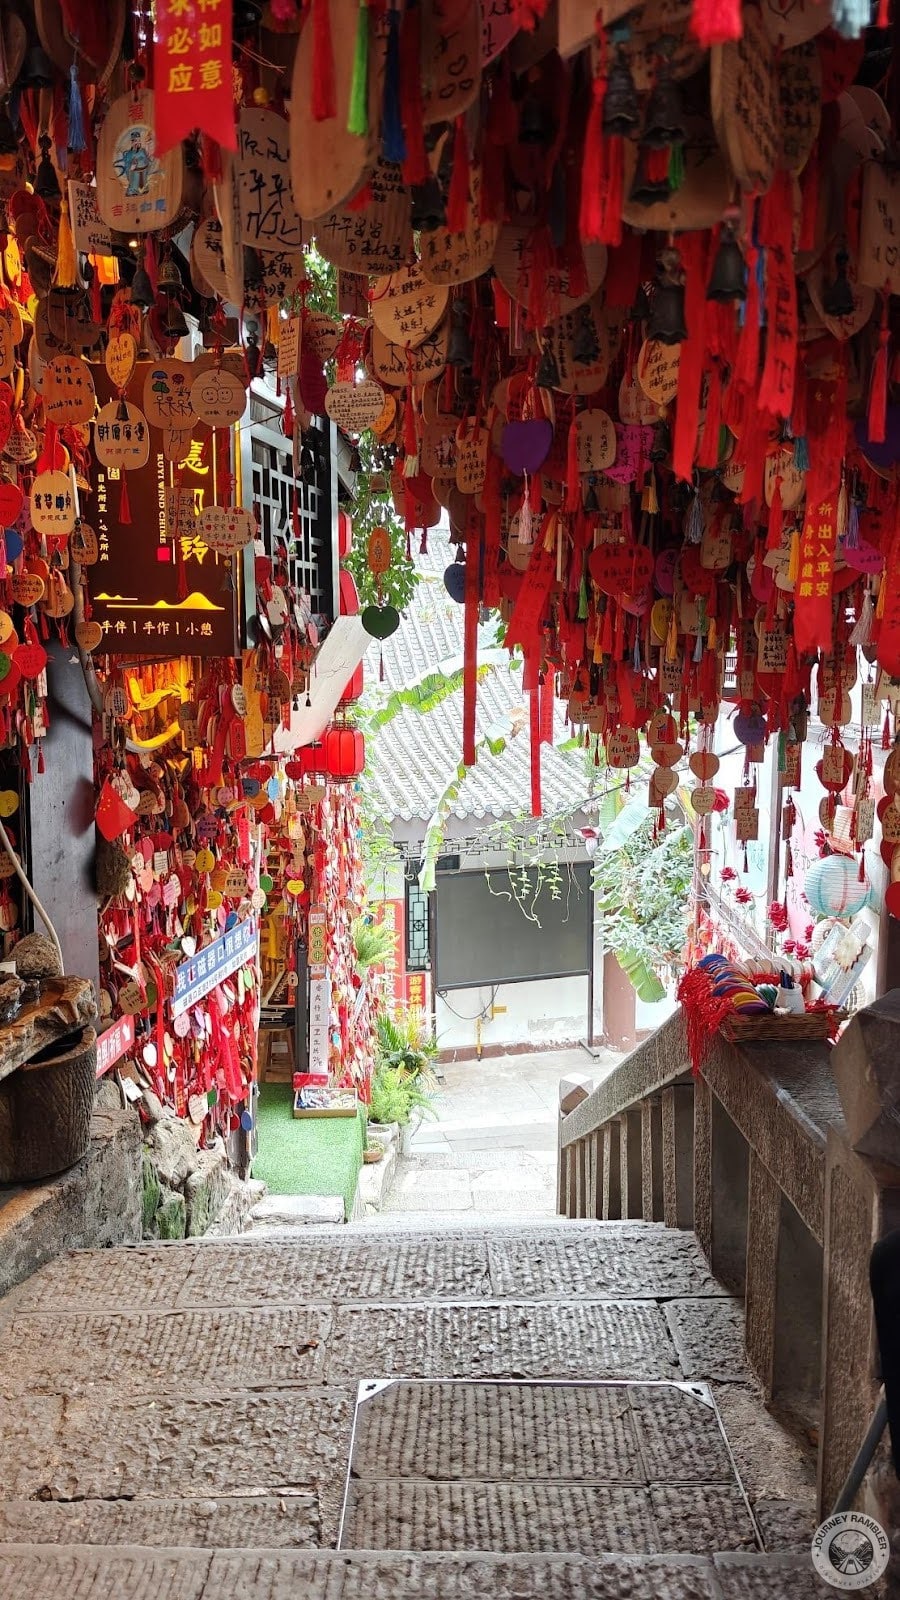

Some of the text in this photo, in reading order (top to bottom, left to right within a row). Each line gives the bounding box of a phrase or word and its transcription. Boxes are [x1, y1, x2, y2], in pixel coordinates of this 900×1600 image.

[158, 481, 166, 509] WIND
[159, 511, 167, 544] CHIME
[816, 503, 833, 597] 祈出入平安
